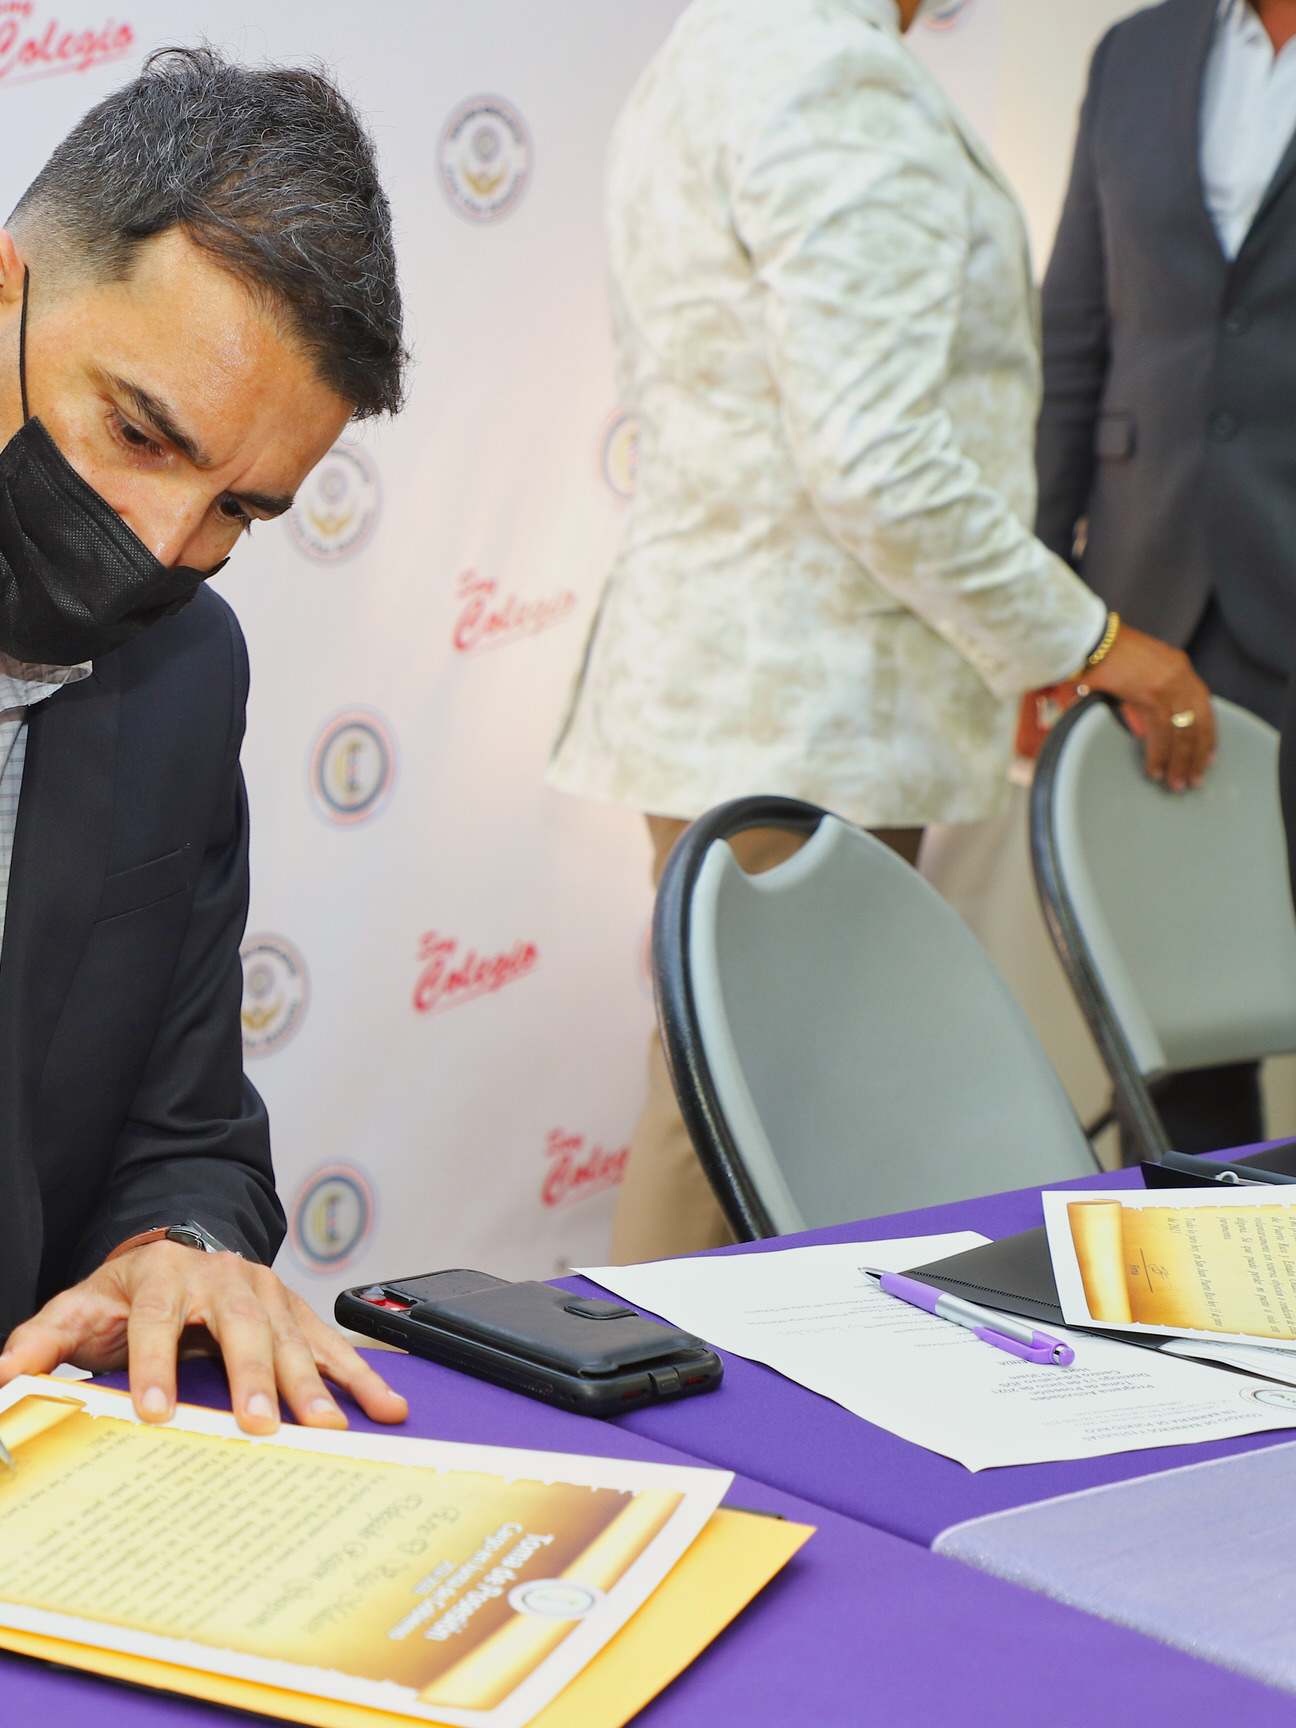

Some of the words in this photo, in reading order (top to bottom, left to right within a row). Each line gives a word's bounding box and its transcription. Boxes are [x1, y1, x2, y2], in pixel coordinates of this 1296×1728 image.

[413, 938, 539, 1013] Colegio
[483, 1522, 522, 1551] Cargo
[500, 1534, 554, 1568] Toma
[483, 1566, 516, 1586] de
[425, 1583, 502, 1640] Posesión
